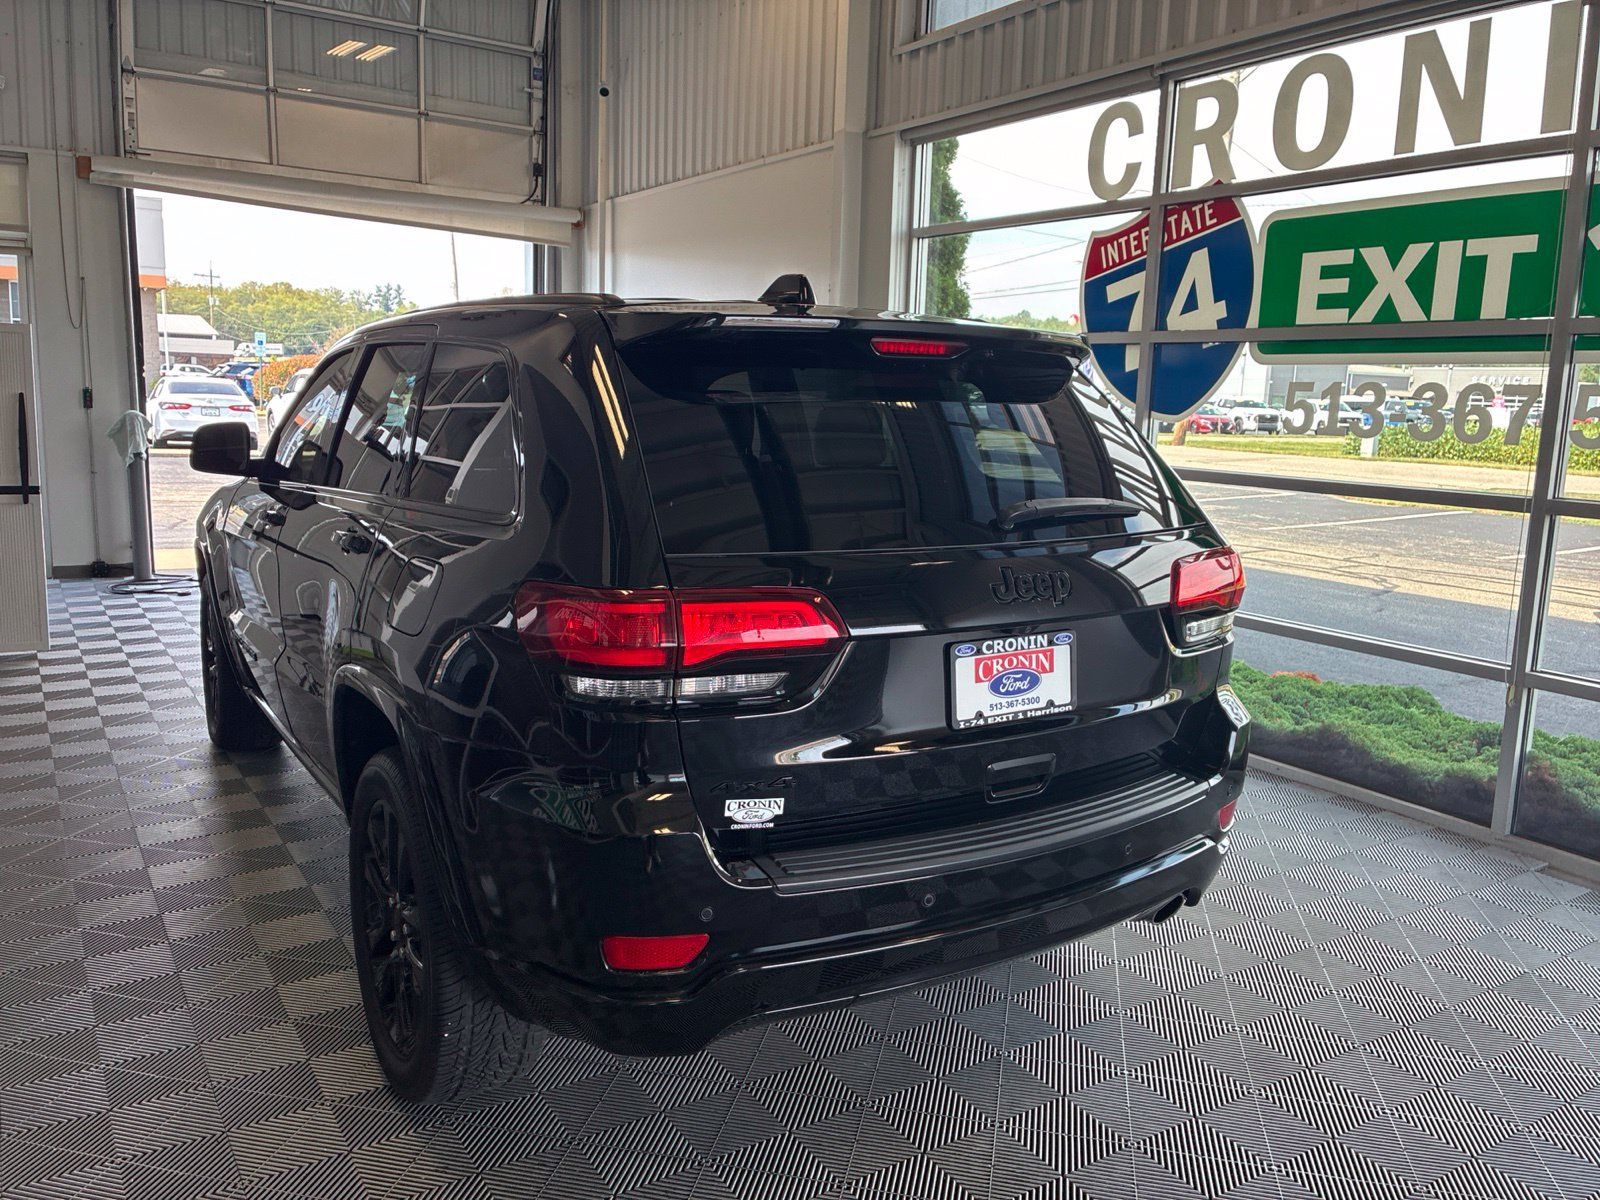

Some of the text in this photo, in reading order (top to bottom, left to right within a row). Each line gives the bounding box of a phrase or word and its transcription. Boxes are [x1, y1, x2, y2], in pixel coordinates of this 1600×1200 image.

[1100, 200, 1217, 269] INTERTATE
[1296, 234, 1539, 325] EXIT
[1106, 247, 1227, 372] 74
[990, 566, 1072, 607] Jeep
[982, 634, 1048, 654] CRONIN
[978, 652, 1051, 680] CRONIN
[1000, 673, 1030, 692] Ford
[989, 696, 1041, 712] 513-367-5300
[959, 705, 1073, 729] I-74 EXIT 1 Harrison
[727, 799, 782, 812] CRONIN
[741, 809, 765, 820] Ford
